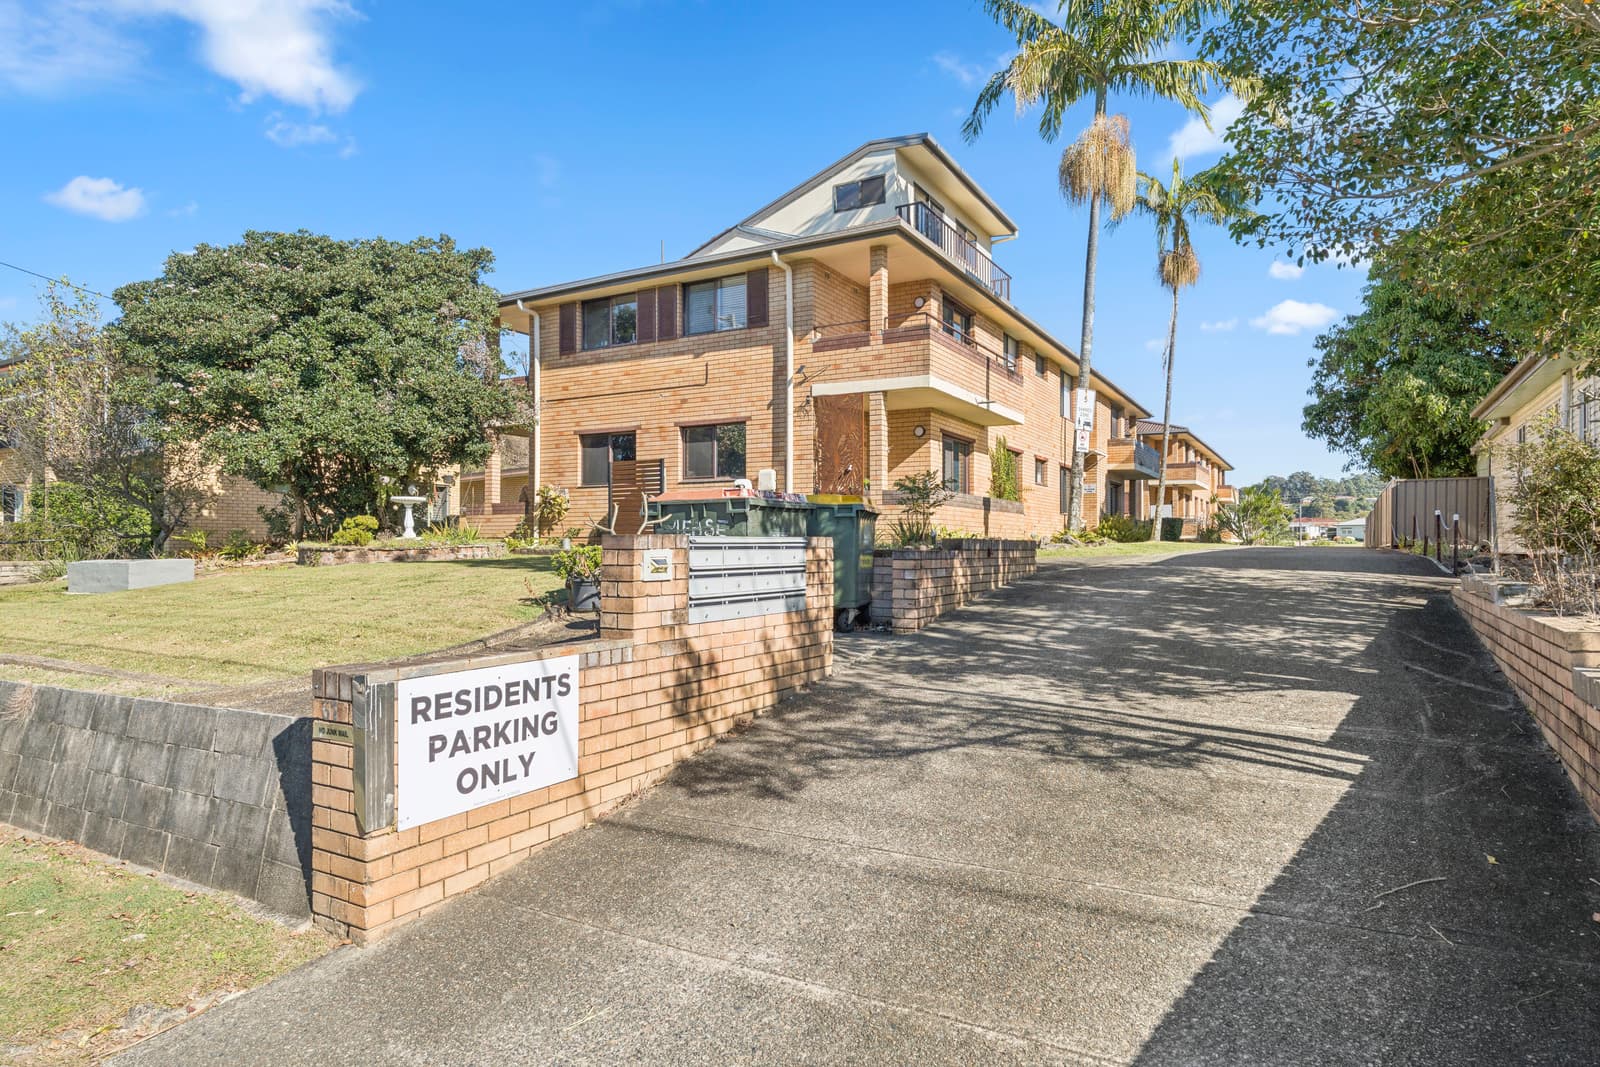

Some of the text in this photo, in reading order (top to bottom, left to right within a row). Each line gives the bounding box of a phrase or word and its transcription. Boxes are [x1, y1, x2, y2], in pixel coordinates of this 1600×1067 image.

[412, 673, 571, 725] RESIDENTS
[429, 711, 558, 763] PARKING
[457, 751, 536, 795] ONLY
